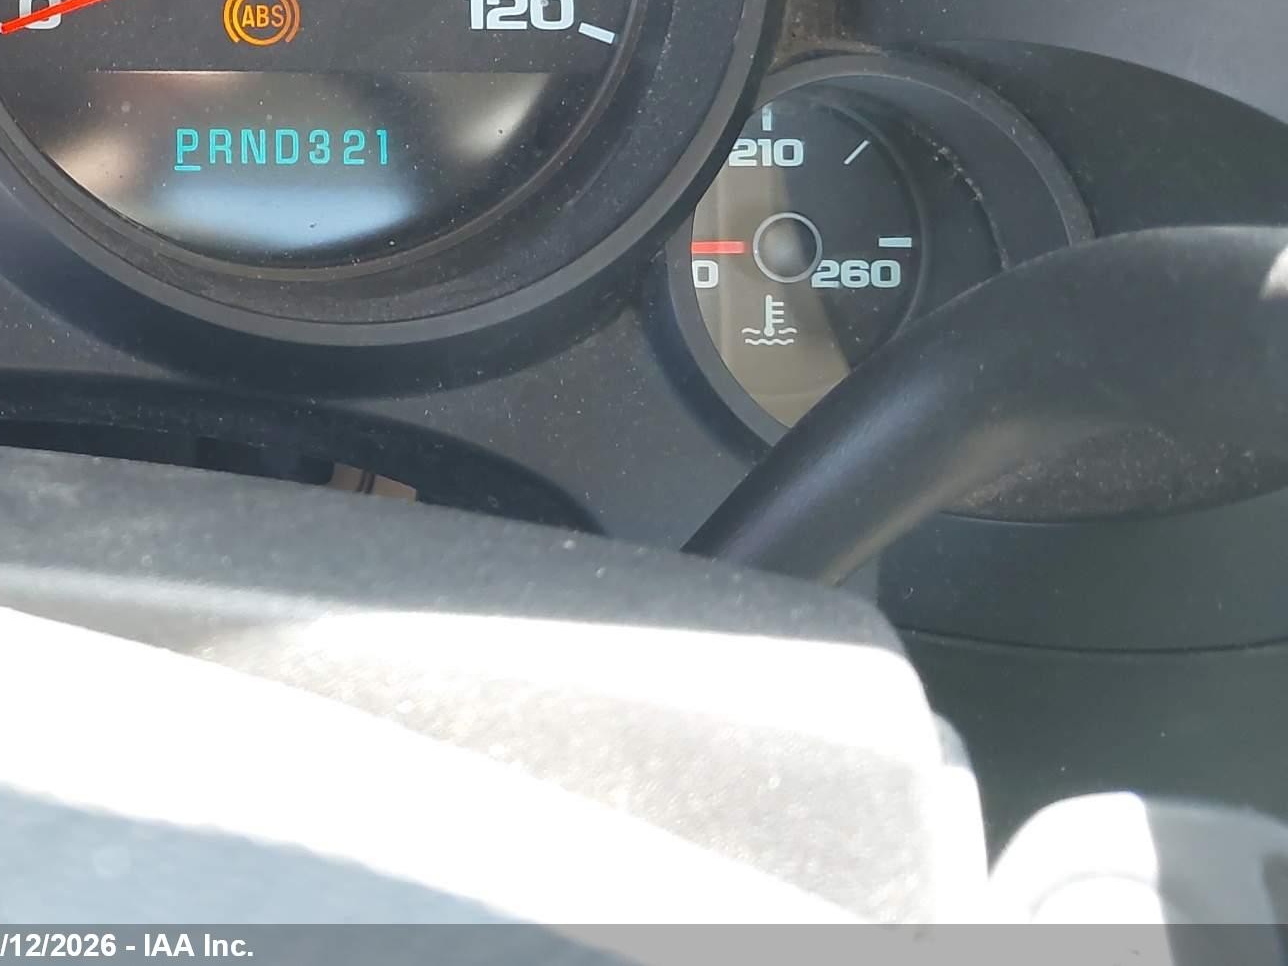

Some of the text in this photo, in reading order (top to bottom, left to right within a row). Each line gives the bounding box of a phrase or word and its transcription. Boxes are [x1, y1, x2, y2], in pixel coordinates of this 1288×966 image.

[241, 4, 284, 28] ABS
[728, 138, 804, 166] 210
[811, 260, 901, 288] 260
